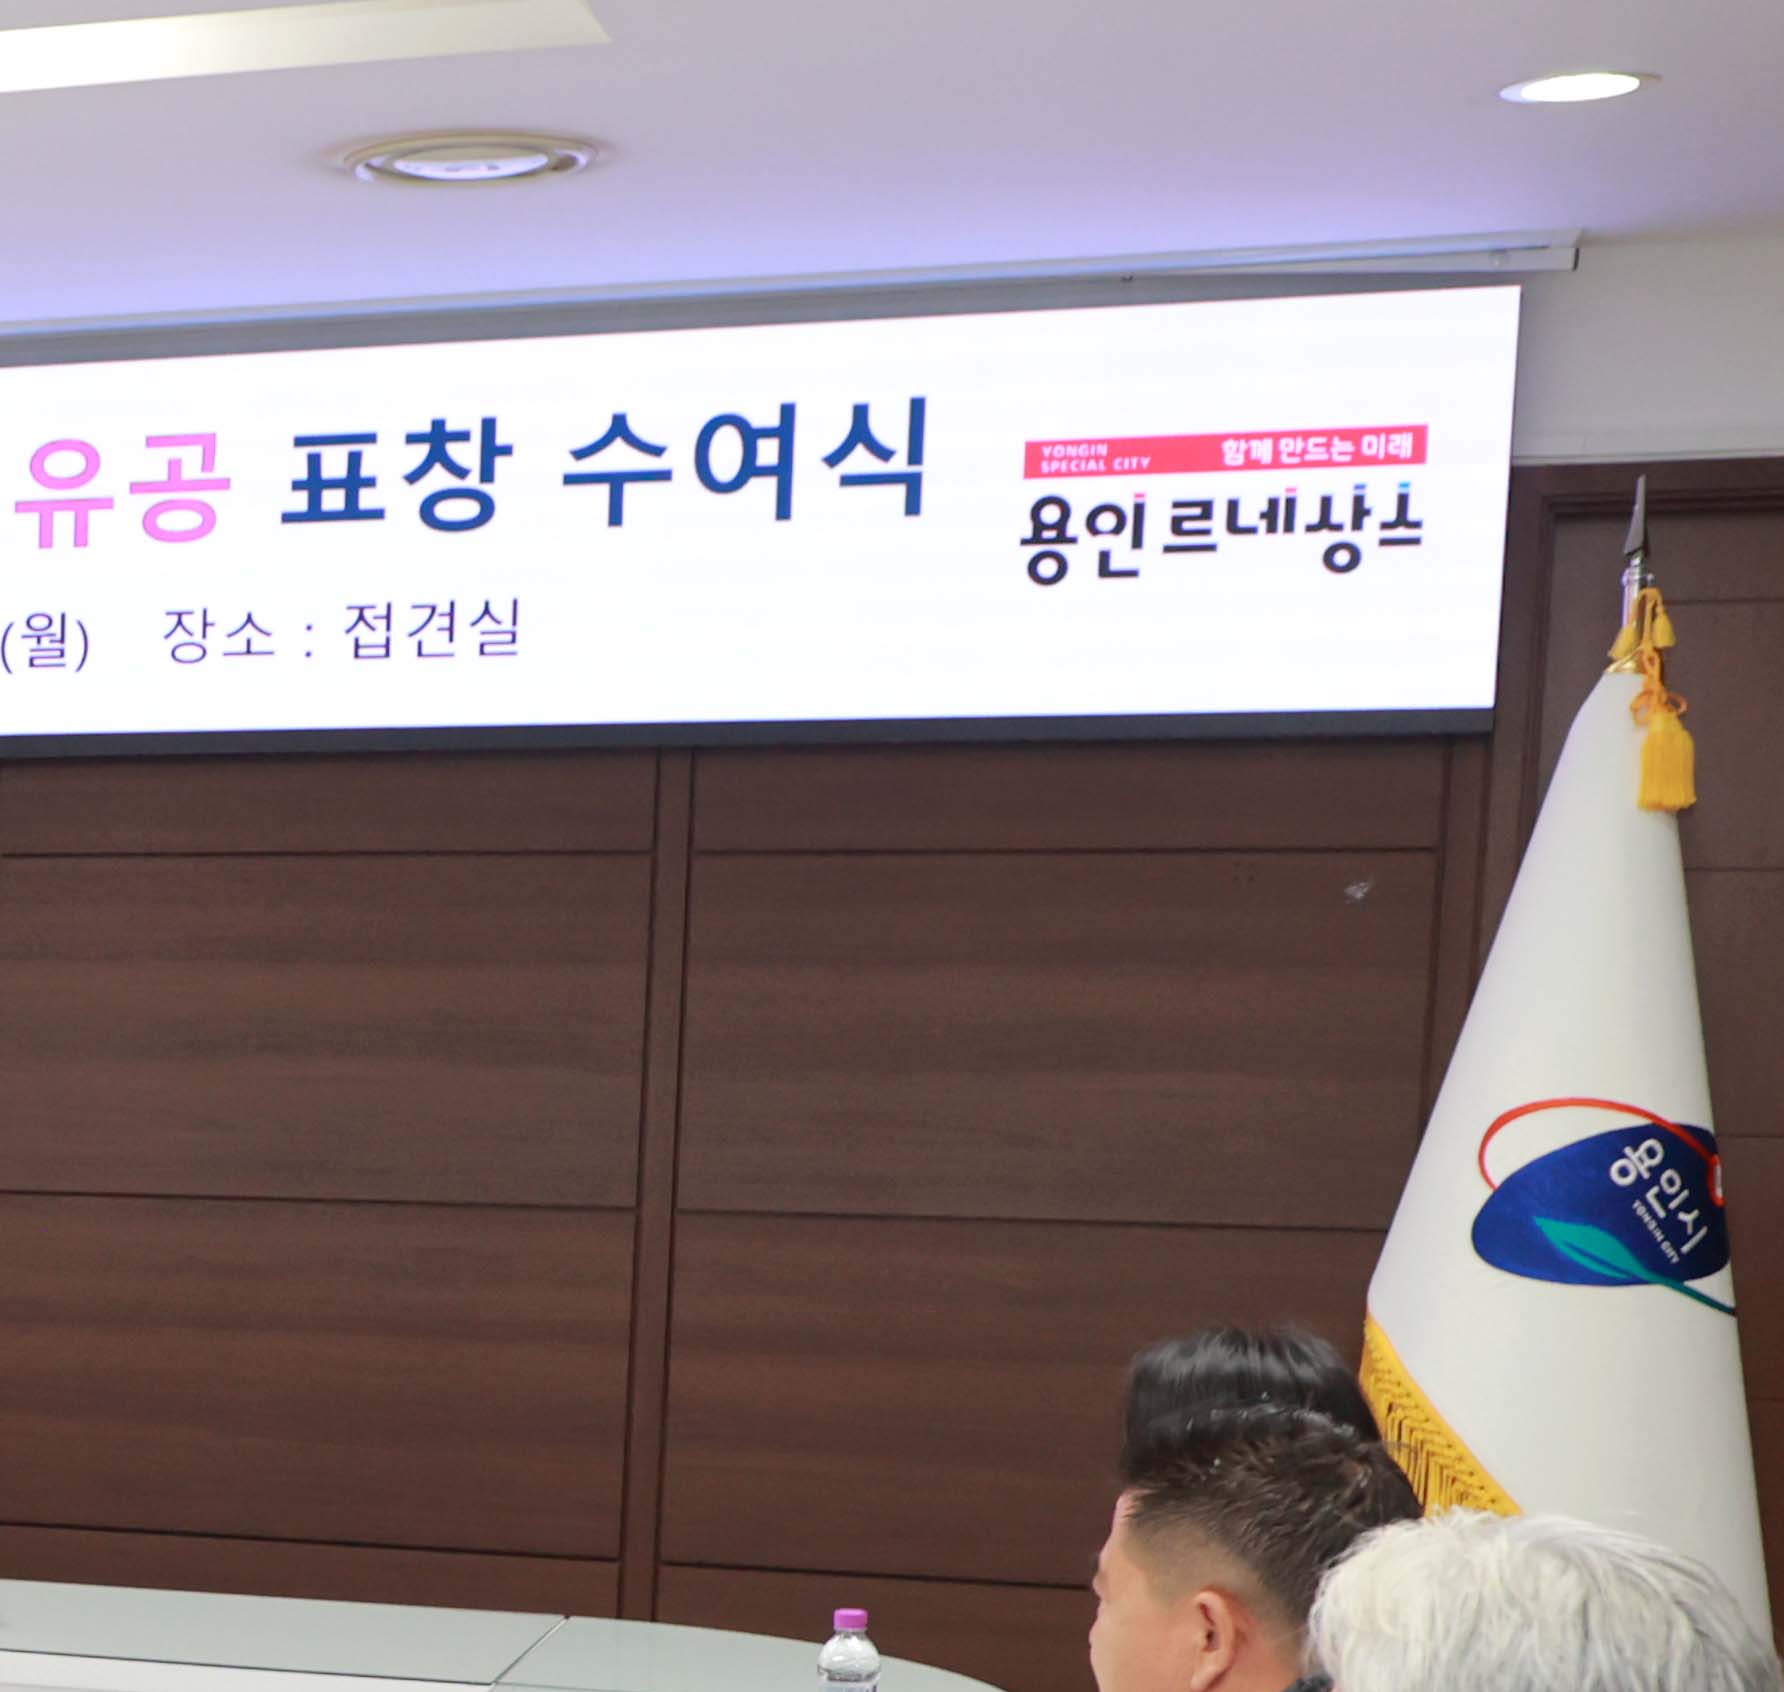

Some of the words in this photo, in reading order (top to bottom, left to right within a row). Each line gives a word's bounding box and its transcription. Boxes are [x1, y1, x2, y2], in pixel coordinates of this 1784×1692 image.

[15, 433, 230, 548] 유공
[281, 416, 513, 533] 표창
[562, 396, 926, 527] 수여식
[1041, 442, 1108, 458] YONGIN
[1041, 458, 1107, 474] SPECIAL
[1113, 456, 1152, 470] CITY
[1221, 437, 1273, 466] 함께
[1361, 431, 1414, 460] 미래
[164, 608, 274, 664] 장소
[345, 598, 518, 659] 접견실
[1610, 1139, 1708, 1254] 용인시
